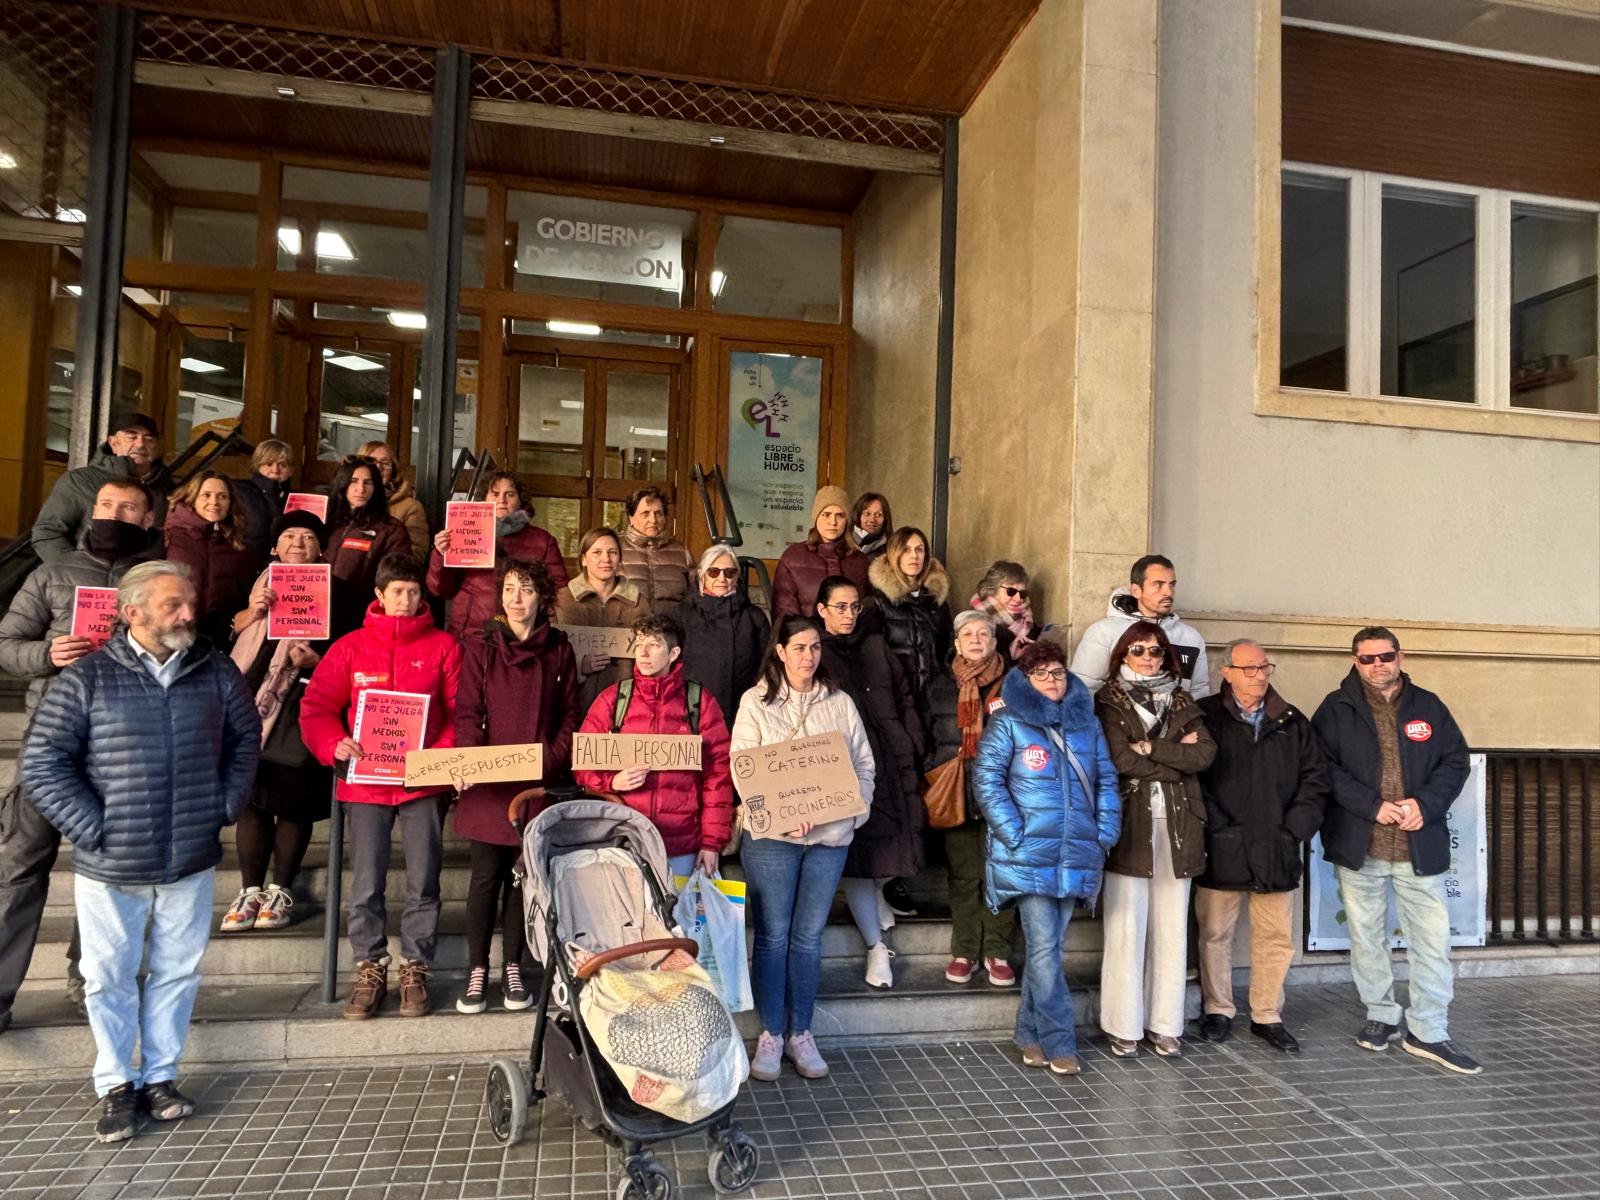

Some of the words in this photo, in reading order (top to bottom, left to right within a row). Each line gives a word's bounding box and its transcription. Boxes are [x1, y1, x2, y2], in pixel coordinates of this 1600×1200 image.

[536, 217, 664, 250] GOBIERNO
[764, 444, 802, 453] espacio
[764, 452, 794, 462] LIBRE
[764, 461, 805, 473] HUMOS
[770, 503, 804, 511] saludable
[290, 584, 306, 592] SIN
[281, 594, 314, 602] MEDIOS
[291, 607, 308, 615] SIN
[275, 618, 322, 626] PERSONAL
[364, 704, 376, 712] NO
[380, 706, 392, 714] SE
[394, 706, 423, 716] JUEGA
[383, 717, 399, 726] SIN
[372, 728, 406, 737] MEDIOS
[1408, 722, 1427, 734] UGT
[380, 742, 397, 752] SIN
[576, 736, 622, 765] FALTA
[634, 739, 702, 767] PERSONAL
[764, 750, 778, 759] NO
[790, 738, 832, 752] QUEREMOS
[360, 753, 406, 764] PERSONA
[767, 753, 840, 773] CATERING
[408, 752, 465, 781] QUEREMOS
[448, 748, 537, 781] RESPUESTAS
[778, 785, 823, 800] QUEREMOS
[780, 790, 855, 820] COCINER@S
